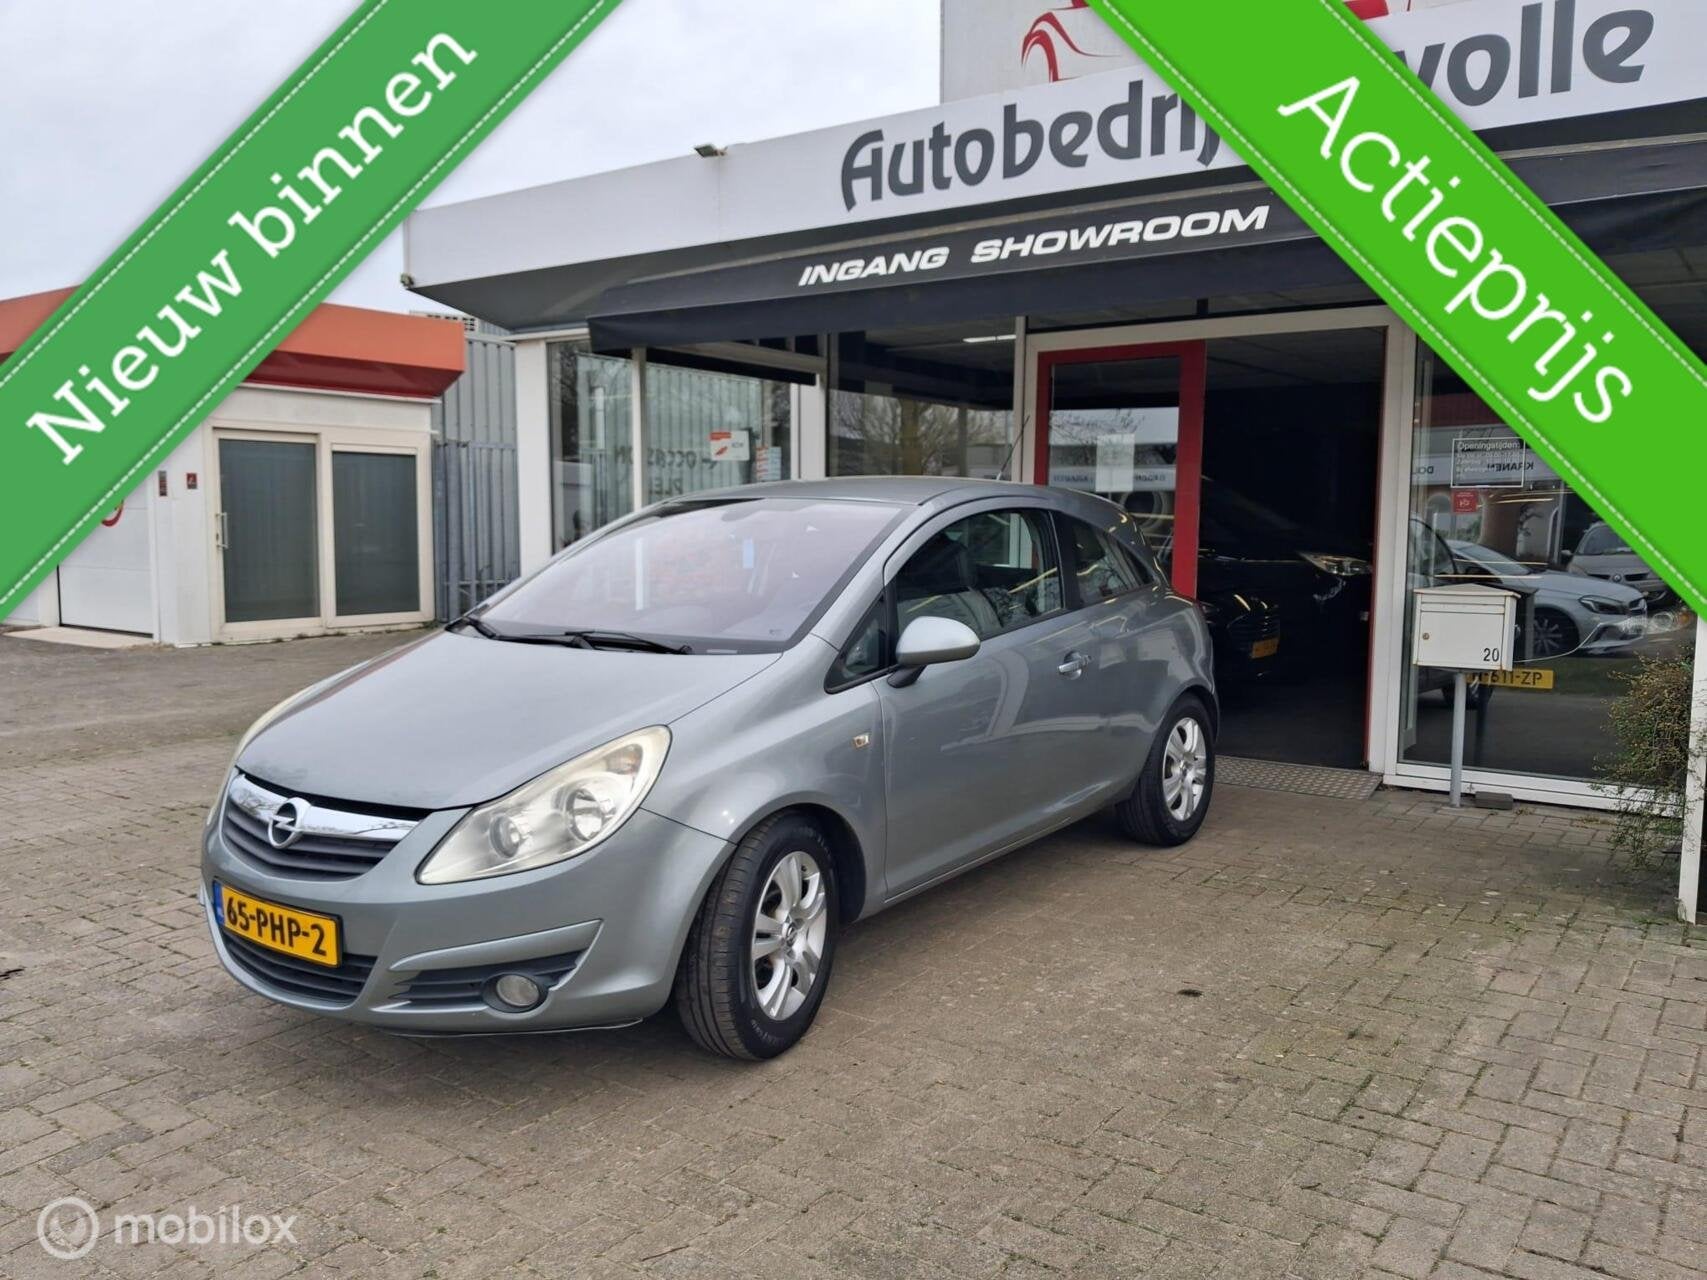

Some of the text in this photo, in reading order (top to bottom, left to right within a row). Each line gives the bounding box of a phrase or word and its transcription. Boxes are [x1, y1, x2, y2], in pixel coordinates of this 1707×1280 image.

[799, 205, 1270, 287] INGANG SHOWROOM
[1483, 647, 1500, 662] 20
[226, 896, 328, 957] 65-PHP-2
